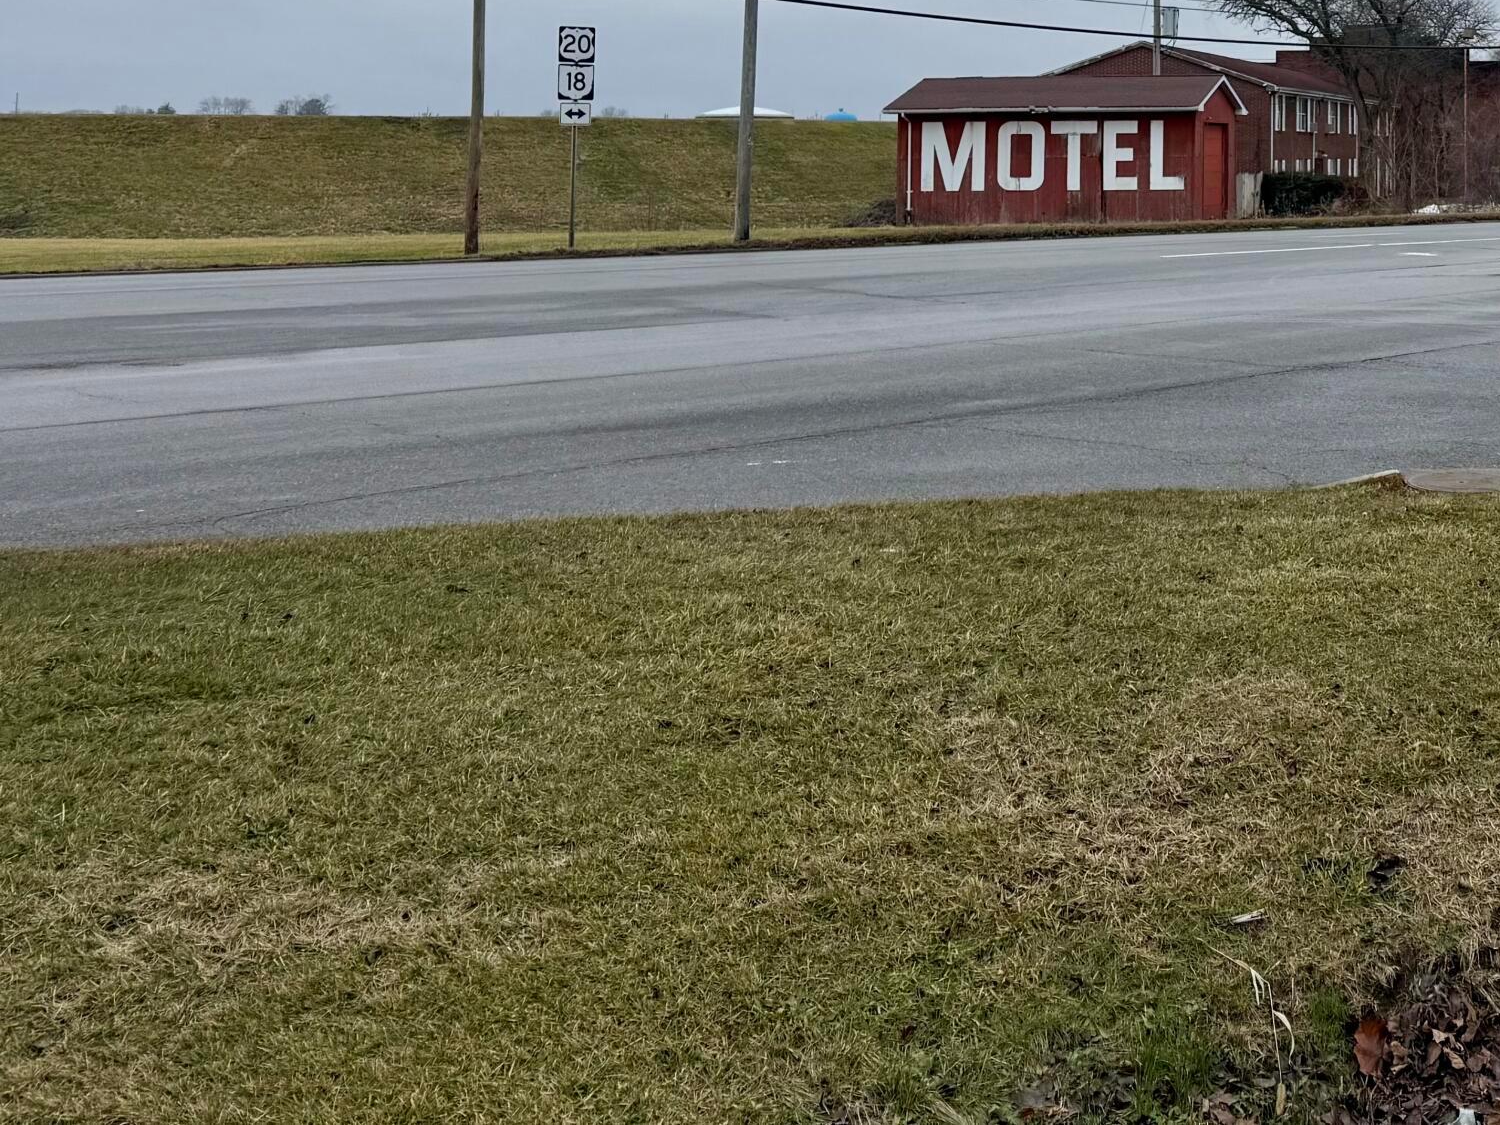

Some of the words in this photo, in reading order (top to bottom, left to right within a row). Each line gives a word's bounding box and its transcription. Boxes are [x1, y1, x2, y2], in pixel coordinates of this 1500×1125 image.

[563, 34, 591, 53] 20
[566, 72, 586, 91] 18
[920, 120, 1185, 192] MOTEL
